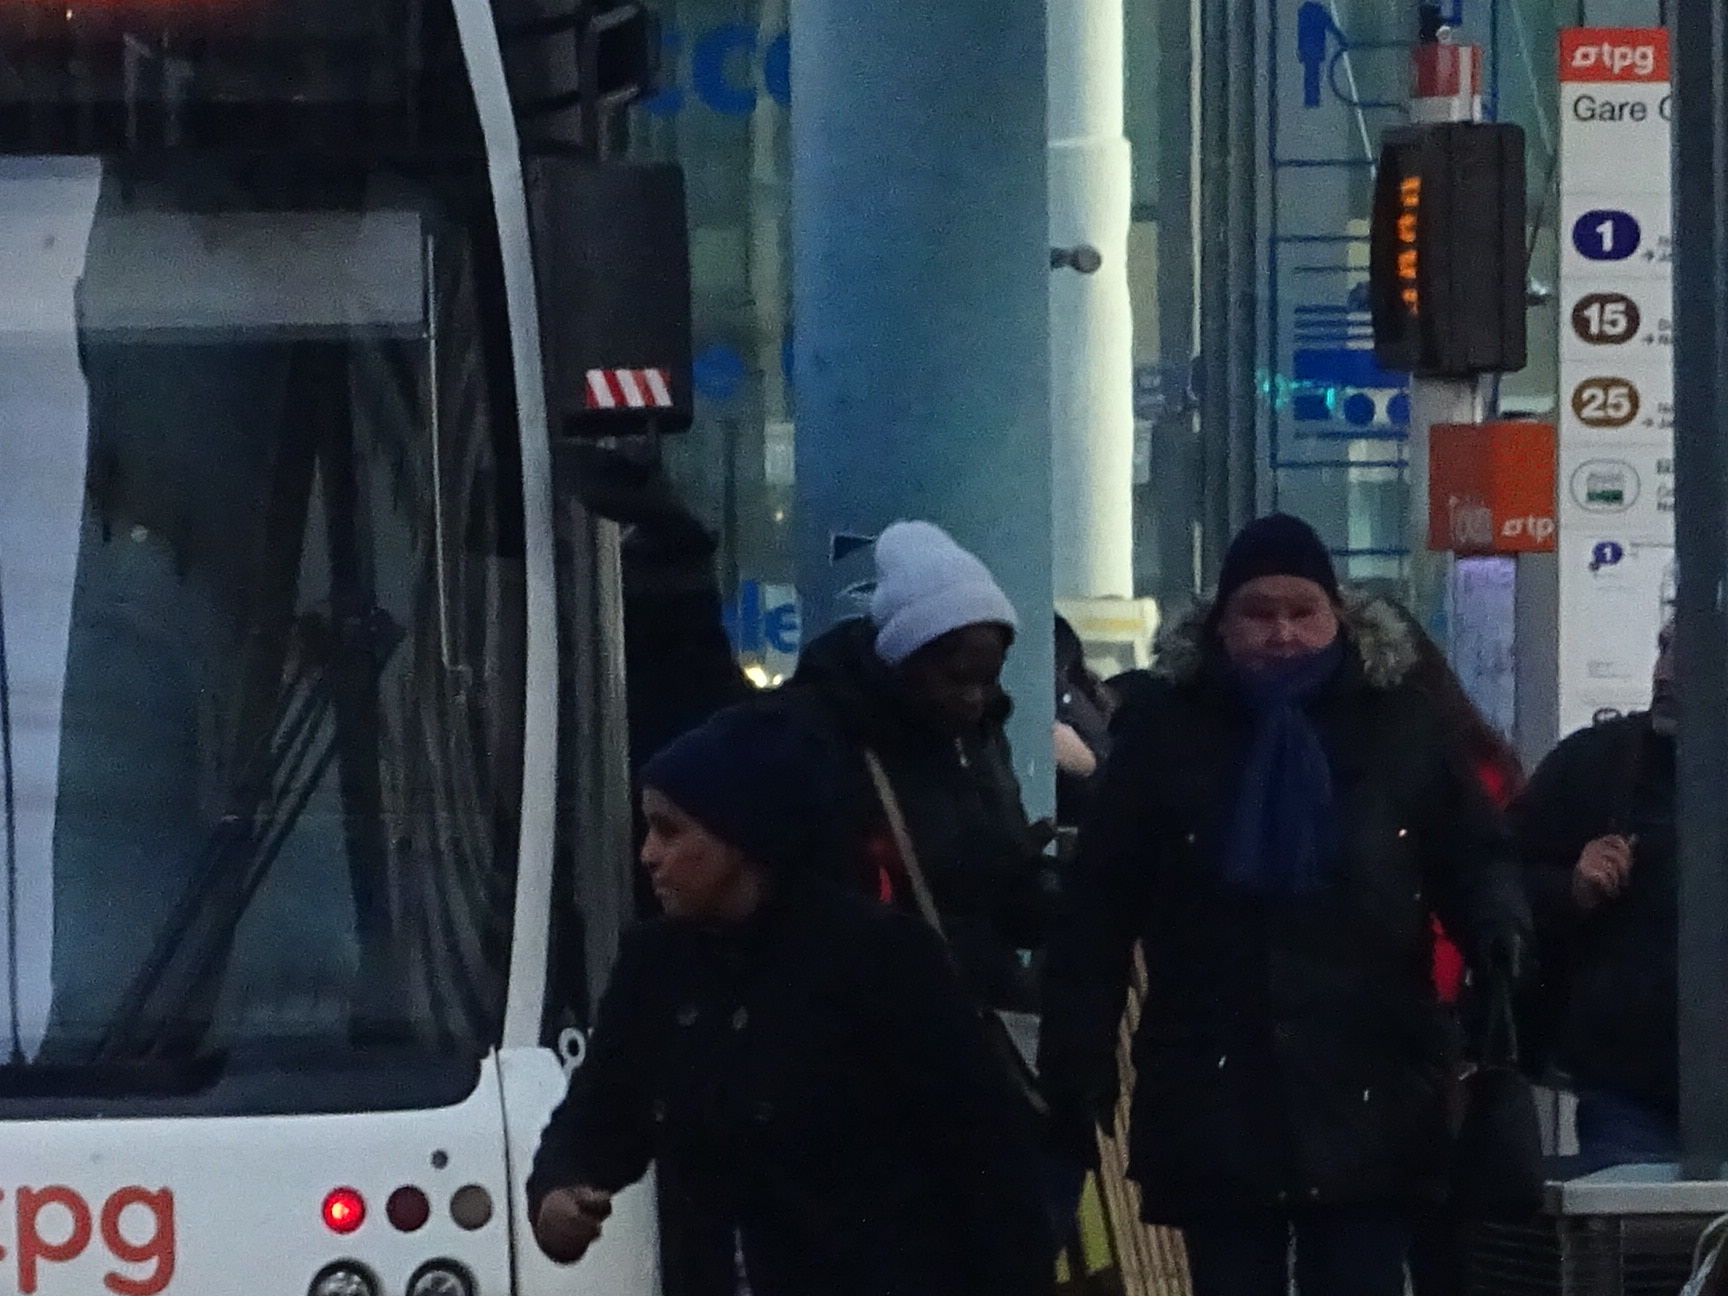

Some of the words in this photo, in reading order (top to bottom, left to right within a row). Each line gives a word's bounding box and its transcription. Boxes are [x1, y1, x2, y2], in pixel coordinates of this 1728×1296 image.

[1573, 94, 1647, 122] Gare
[1595, 219, 1614, 253] 1
[1583, 302, 1628, 336] 15
[1580, 386, 1632, 419] 25
